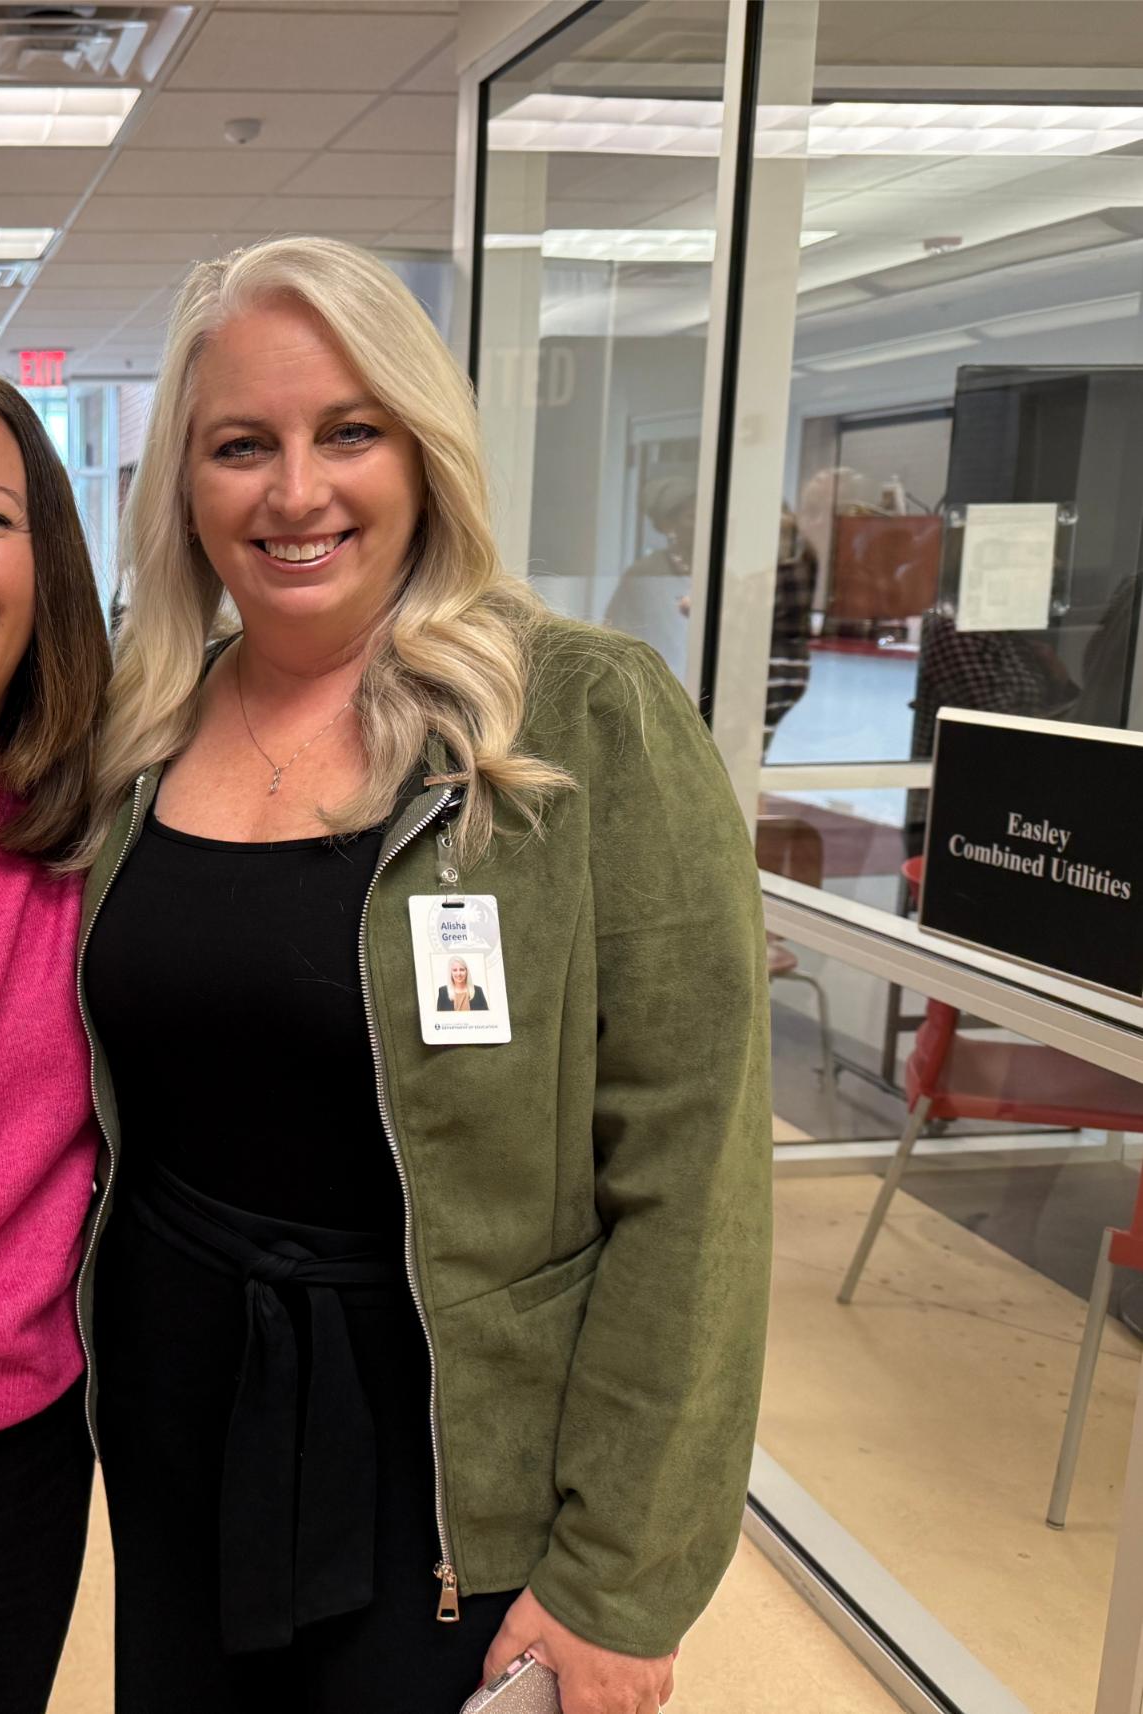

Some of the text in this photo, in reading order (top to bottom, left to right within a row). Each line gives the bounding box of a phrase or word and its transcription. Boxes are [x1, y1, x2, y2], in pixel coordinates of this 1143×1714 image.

[20, 351, 65, 386] EXIT
[1007, 811, 1071, 852] Easley
[948, 833, 1131, 900] Combined Utilities
[441, 921, 466, 930] Alisha
[441, 933, 468, 941] Green
